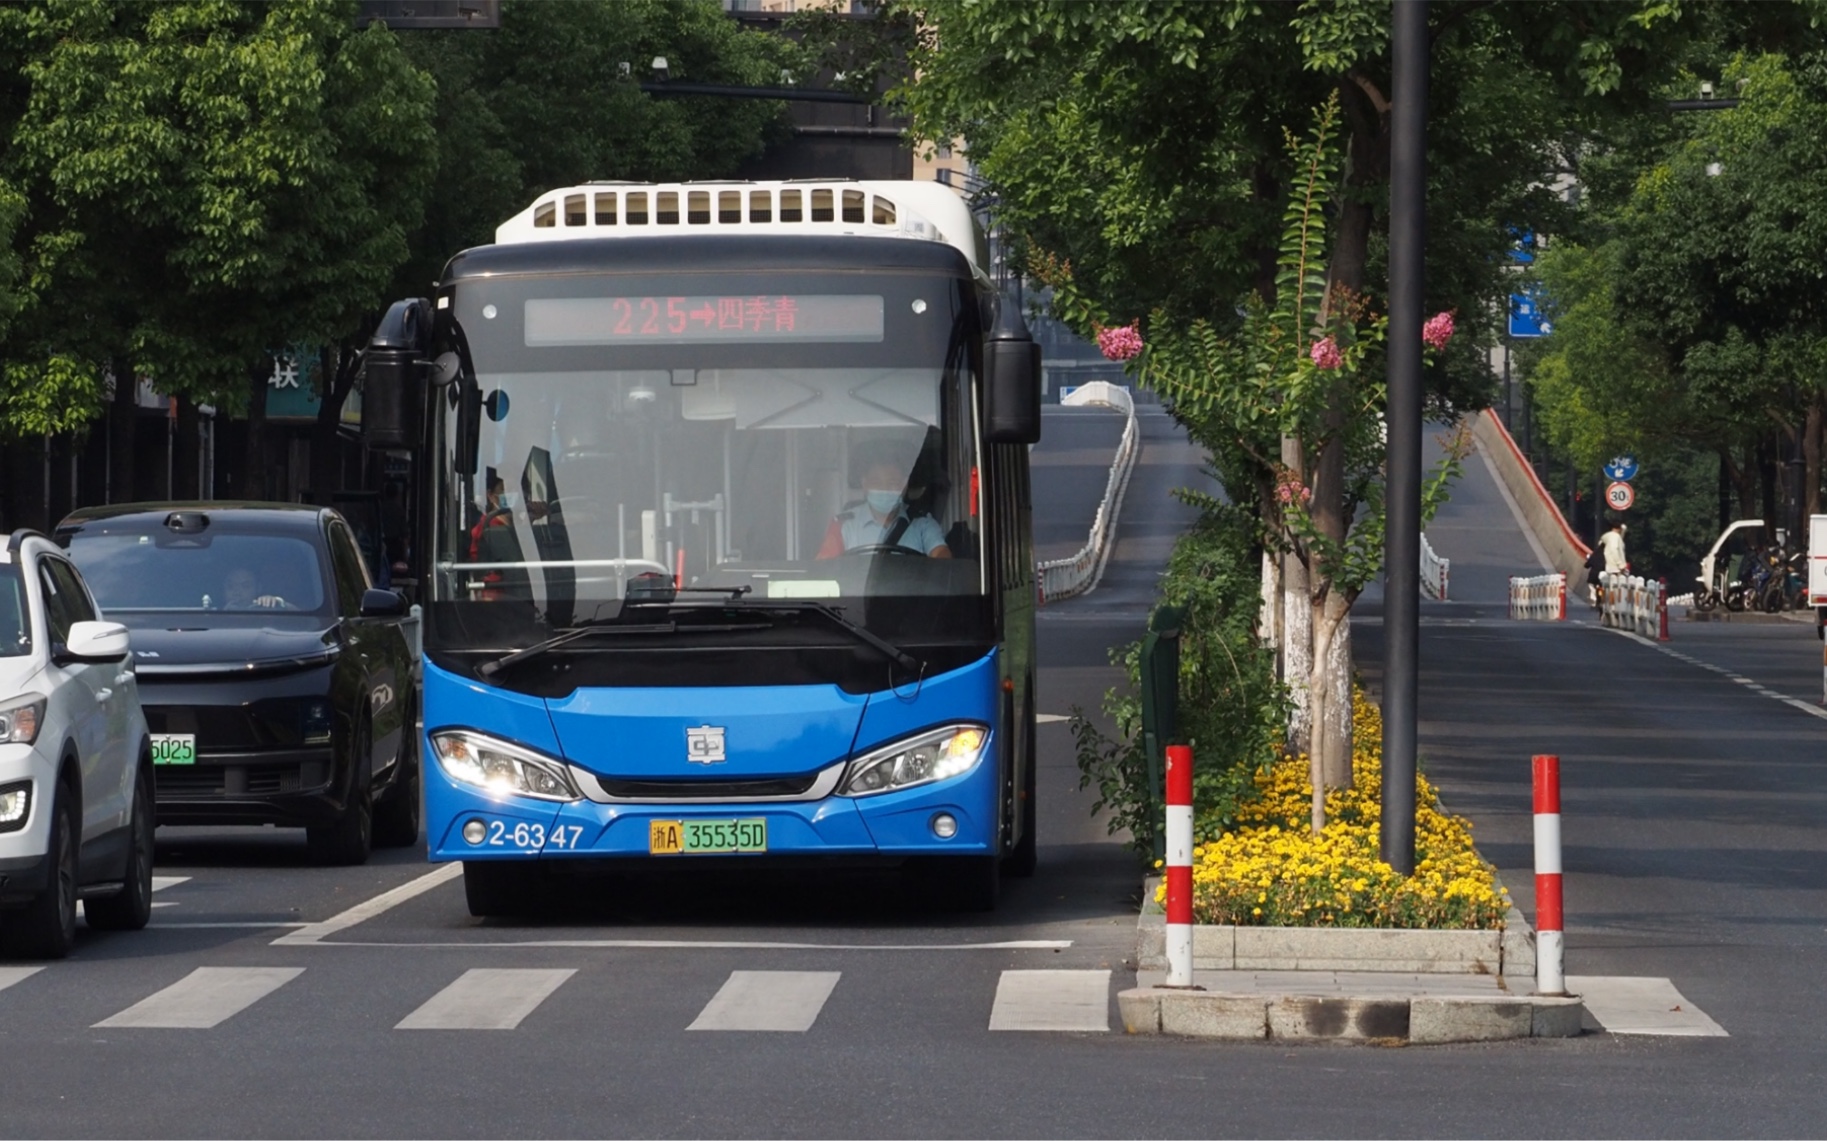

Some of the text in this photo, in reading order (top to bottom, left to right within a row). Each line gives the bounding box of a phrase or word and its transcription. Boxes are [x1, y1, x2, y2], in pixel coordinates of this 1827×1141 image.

[612, 295, 799, 335] 225 四季青
[1611, 490, 1626, 502] 30
[489, 820, 584, 850] 2-6347
[689, 824, 764, 848] 35535D
